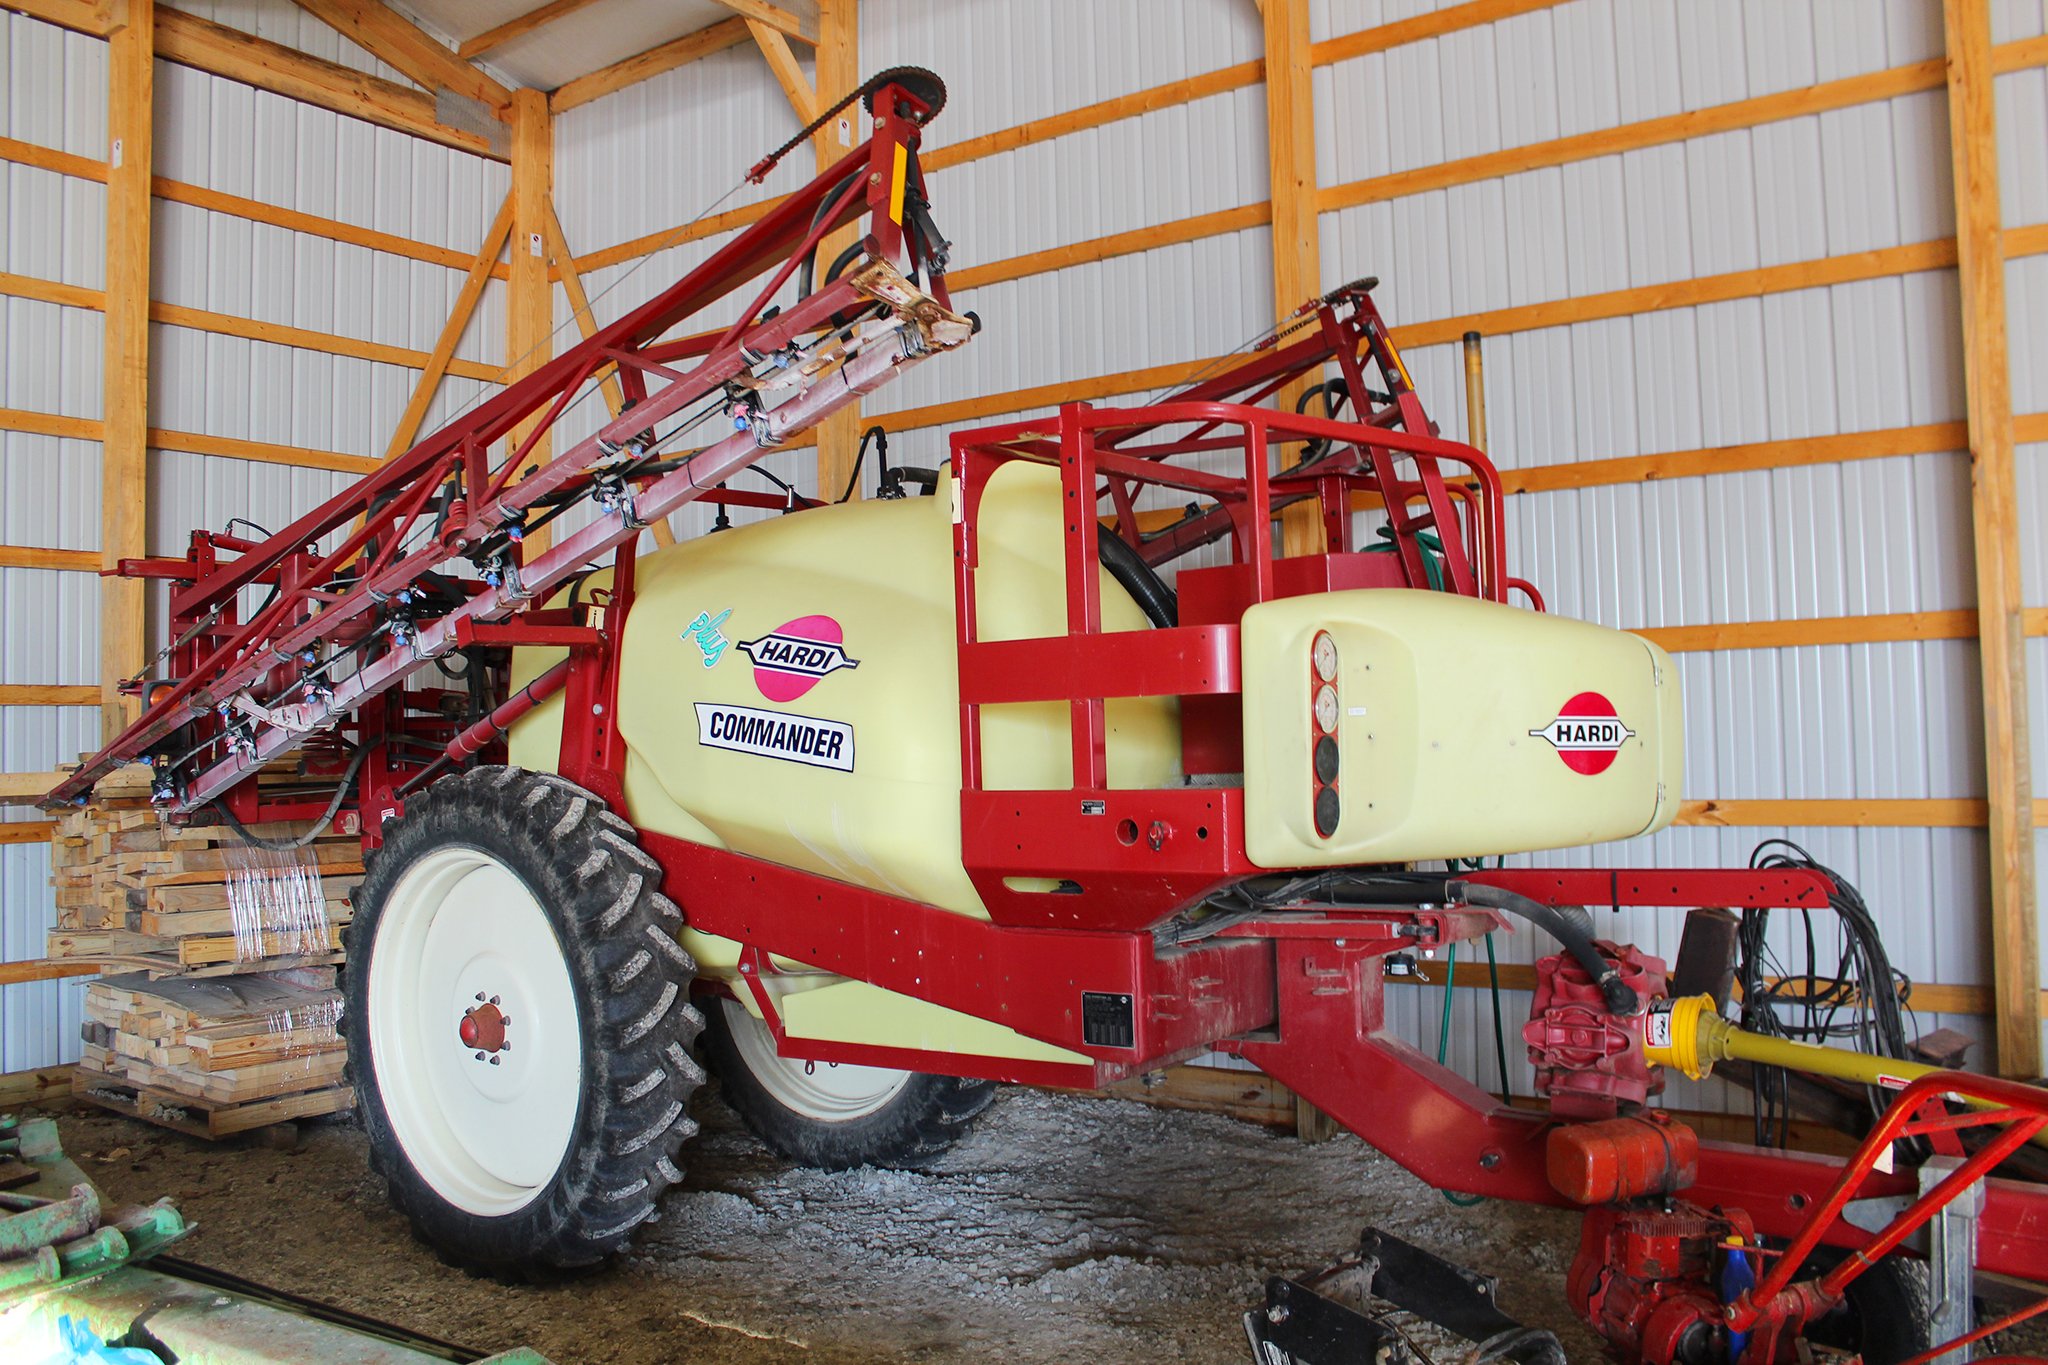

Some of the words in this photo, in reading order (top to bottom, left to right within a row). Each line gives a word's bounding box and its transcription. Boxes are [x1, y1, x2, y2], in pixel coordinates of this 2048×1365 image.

[759, 641, 835, 669] HARDI
[710, 711, 844, 760] COMMANDER
[1556, 725, 1618, 742] HARDI
